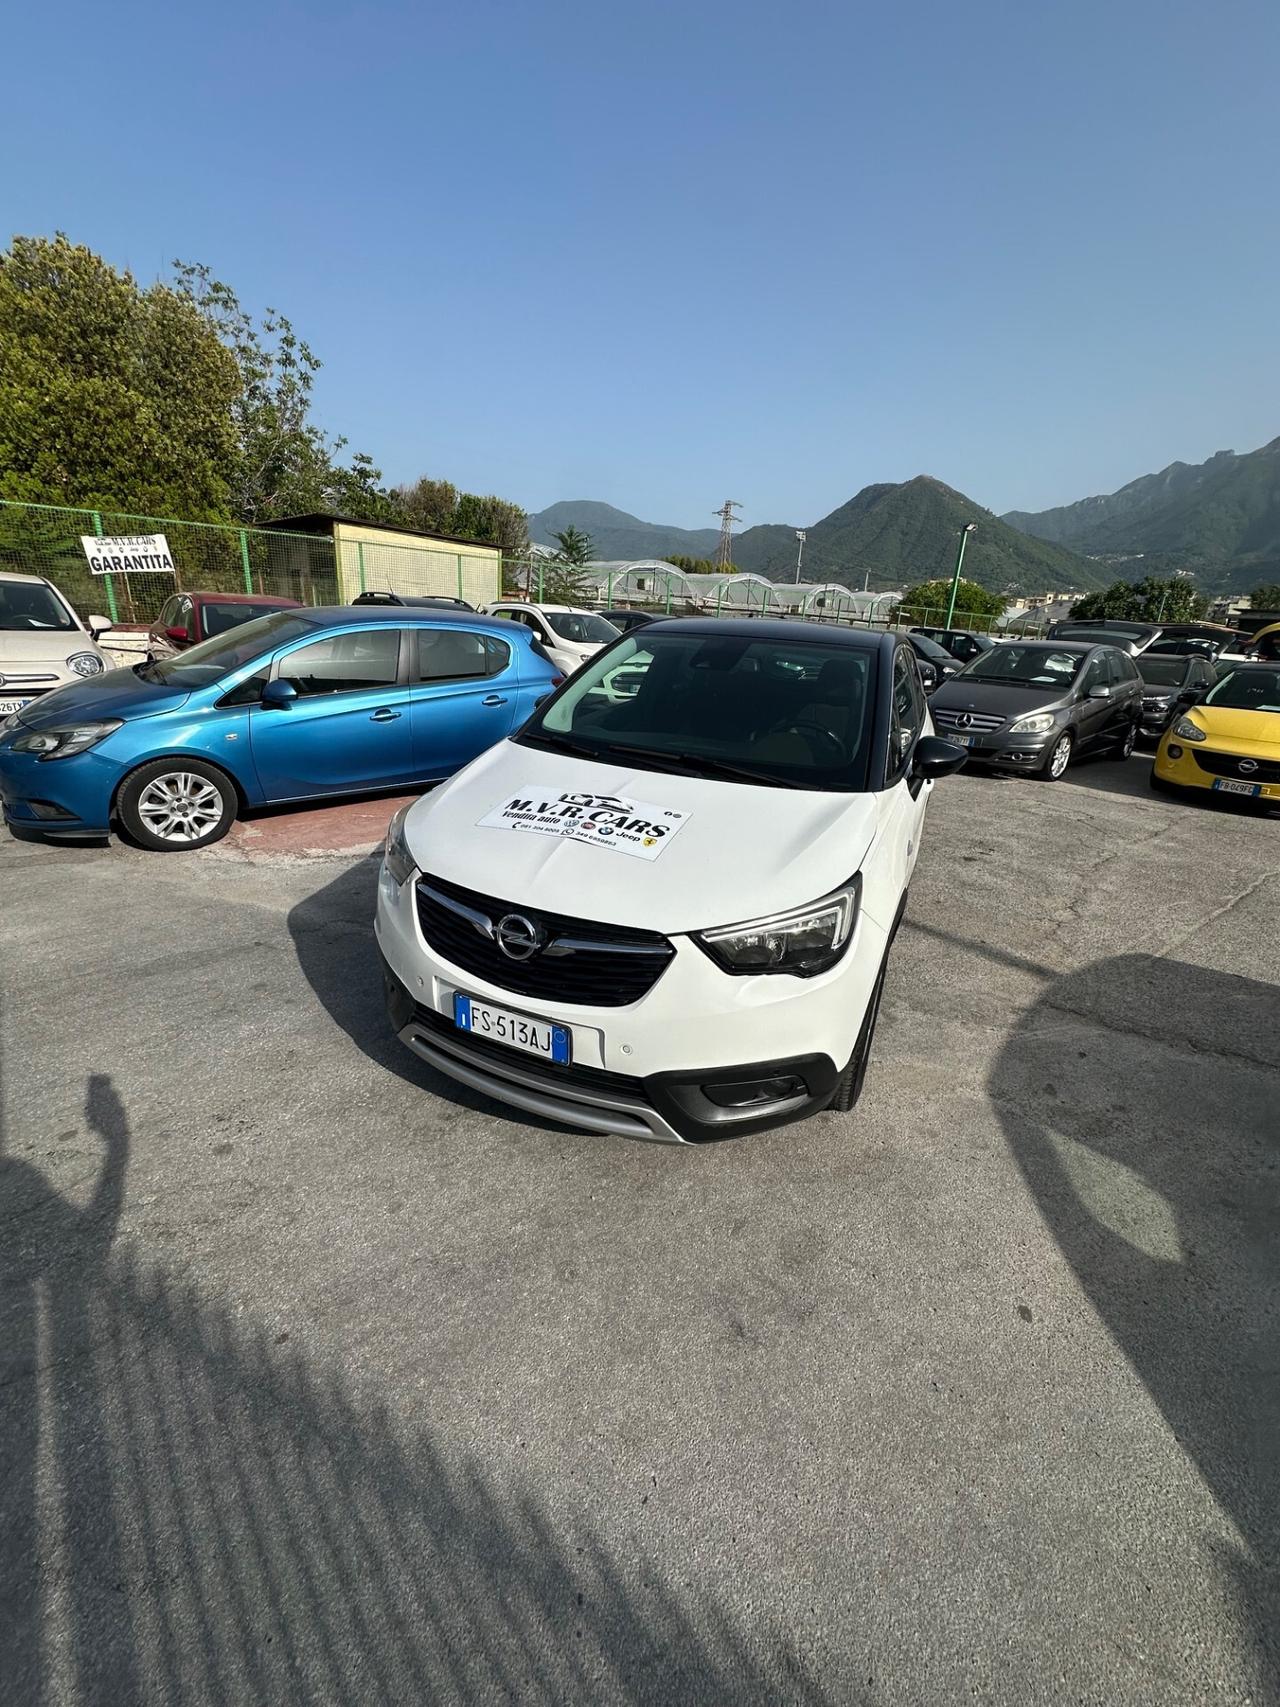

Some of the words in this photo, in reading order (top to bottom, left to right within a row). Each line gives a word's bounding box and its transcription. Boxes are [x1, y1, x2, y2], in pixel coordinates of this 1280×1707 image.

[90, 554, 173, 572] GARANTITA
[502, 810, 538, 821] Vendita
[537, 815, 561, 824] auto
[615, 831, 641, 842] Jeep
